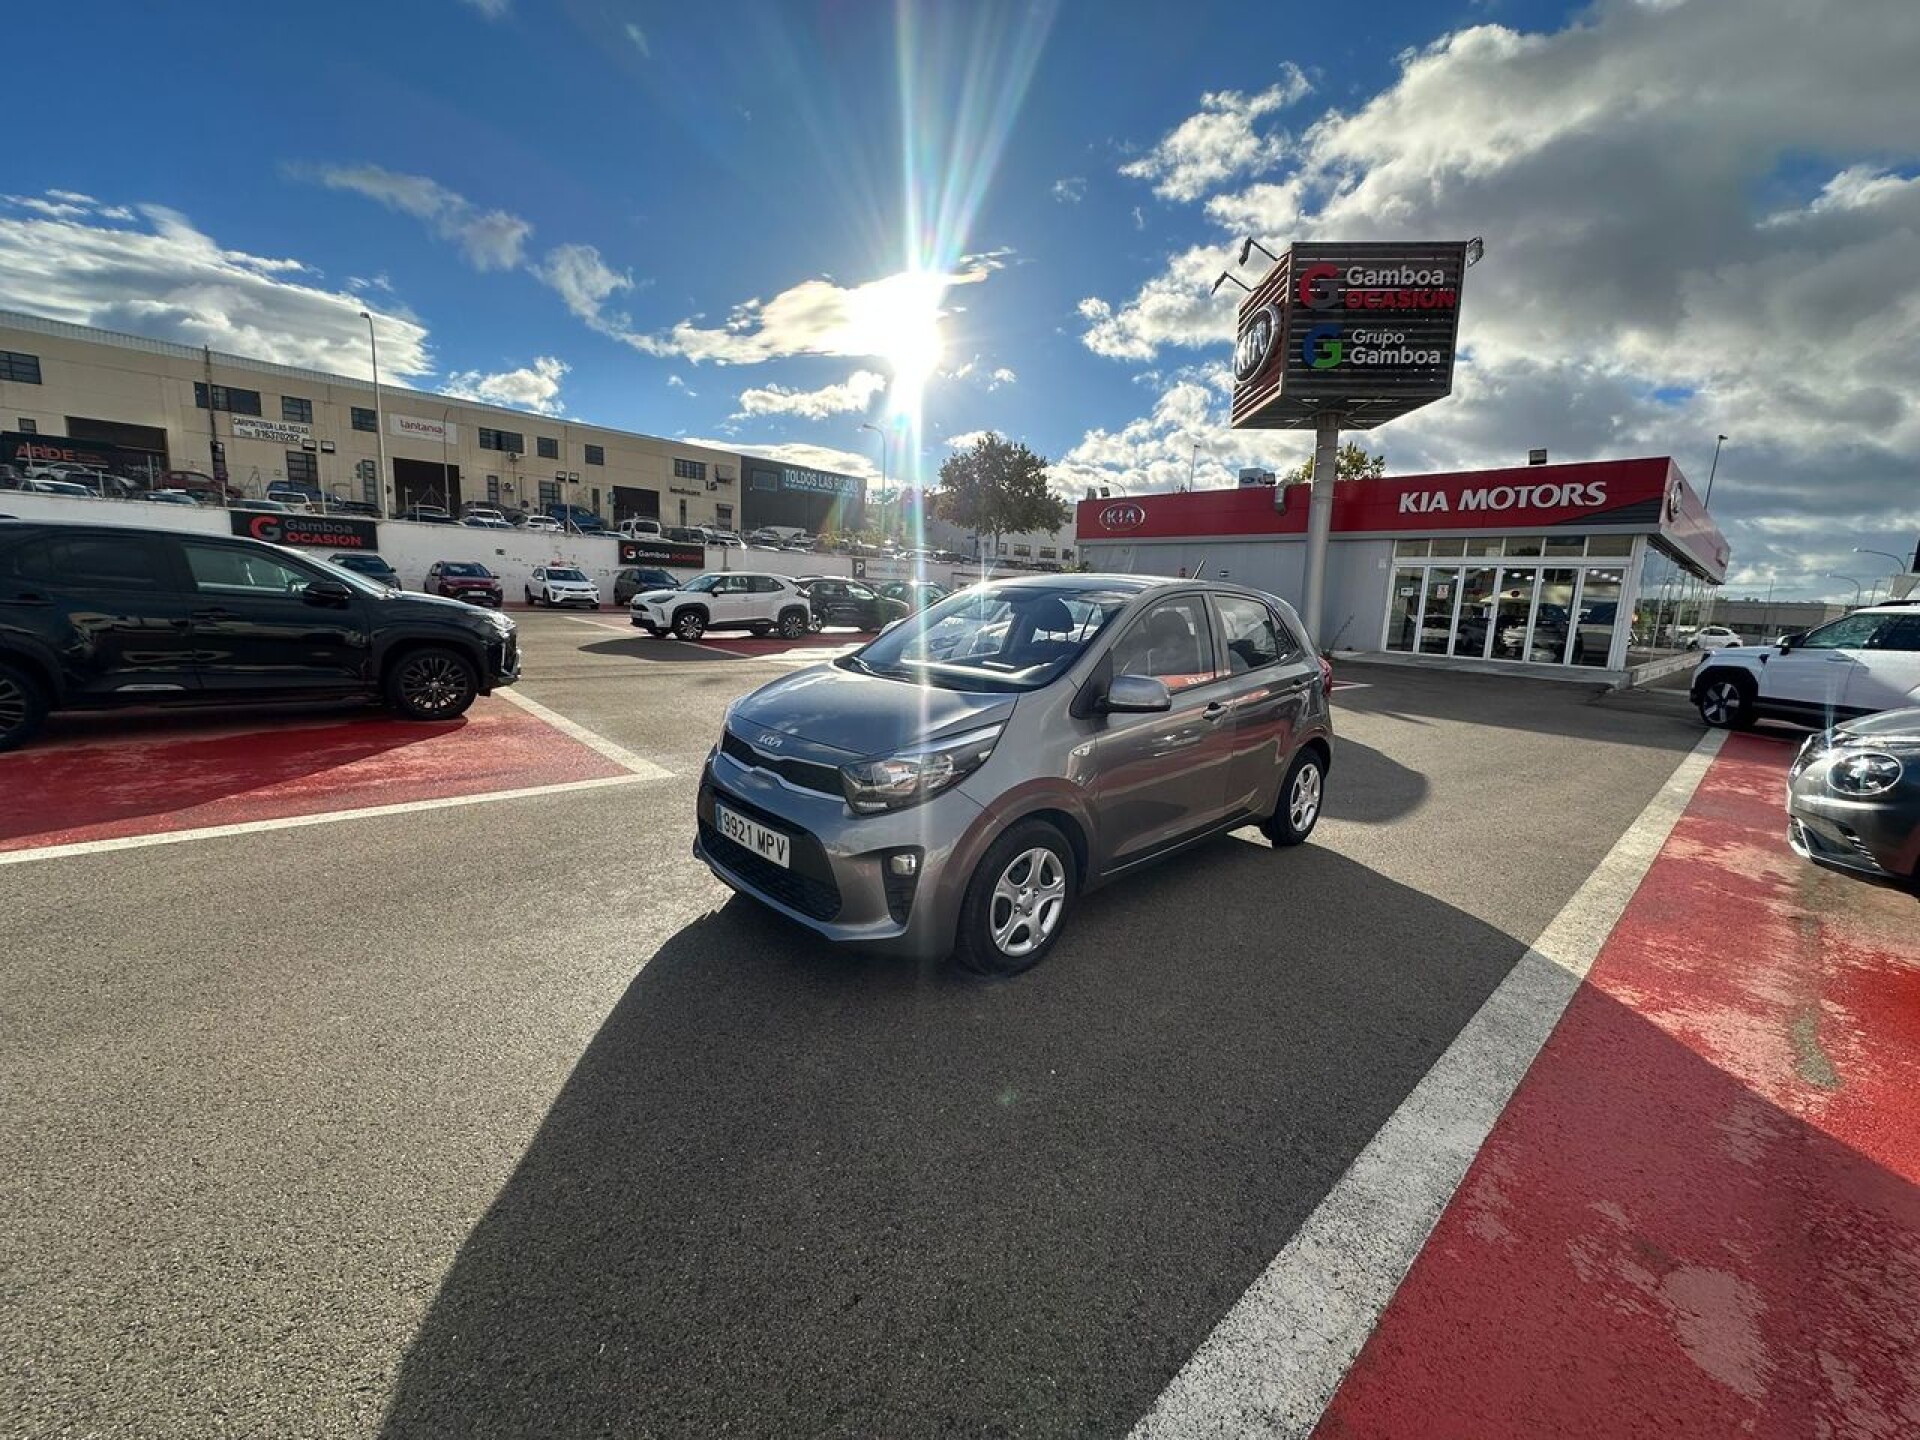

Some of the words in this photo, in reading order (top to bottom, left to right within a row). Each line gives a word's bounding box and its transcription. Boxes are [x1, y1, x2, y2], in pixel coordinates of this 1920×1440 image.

[1346, 265, 1444, 286] Gamboa
[1352, 330, 1405, 348] Grupo
[1349, 346, 1441, 364] Gamboa
[785, 470, 816, 487] TOLDOS
[1399, 490, 1450, 514] KIA
[1458, 481, 1606, 511] MOTORS
[1107, 509, 1136, 524] KIA
[285, 519, 353, 534] Gamboa
[638, 549, 670, 559] Gamboa
[723, 812, 753, 845] 9921
[757, 829, 786, 861] MPV
